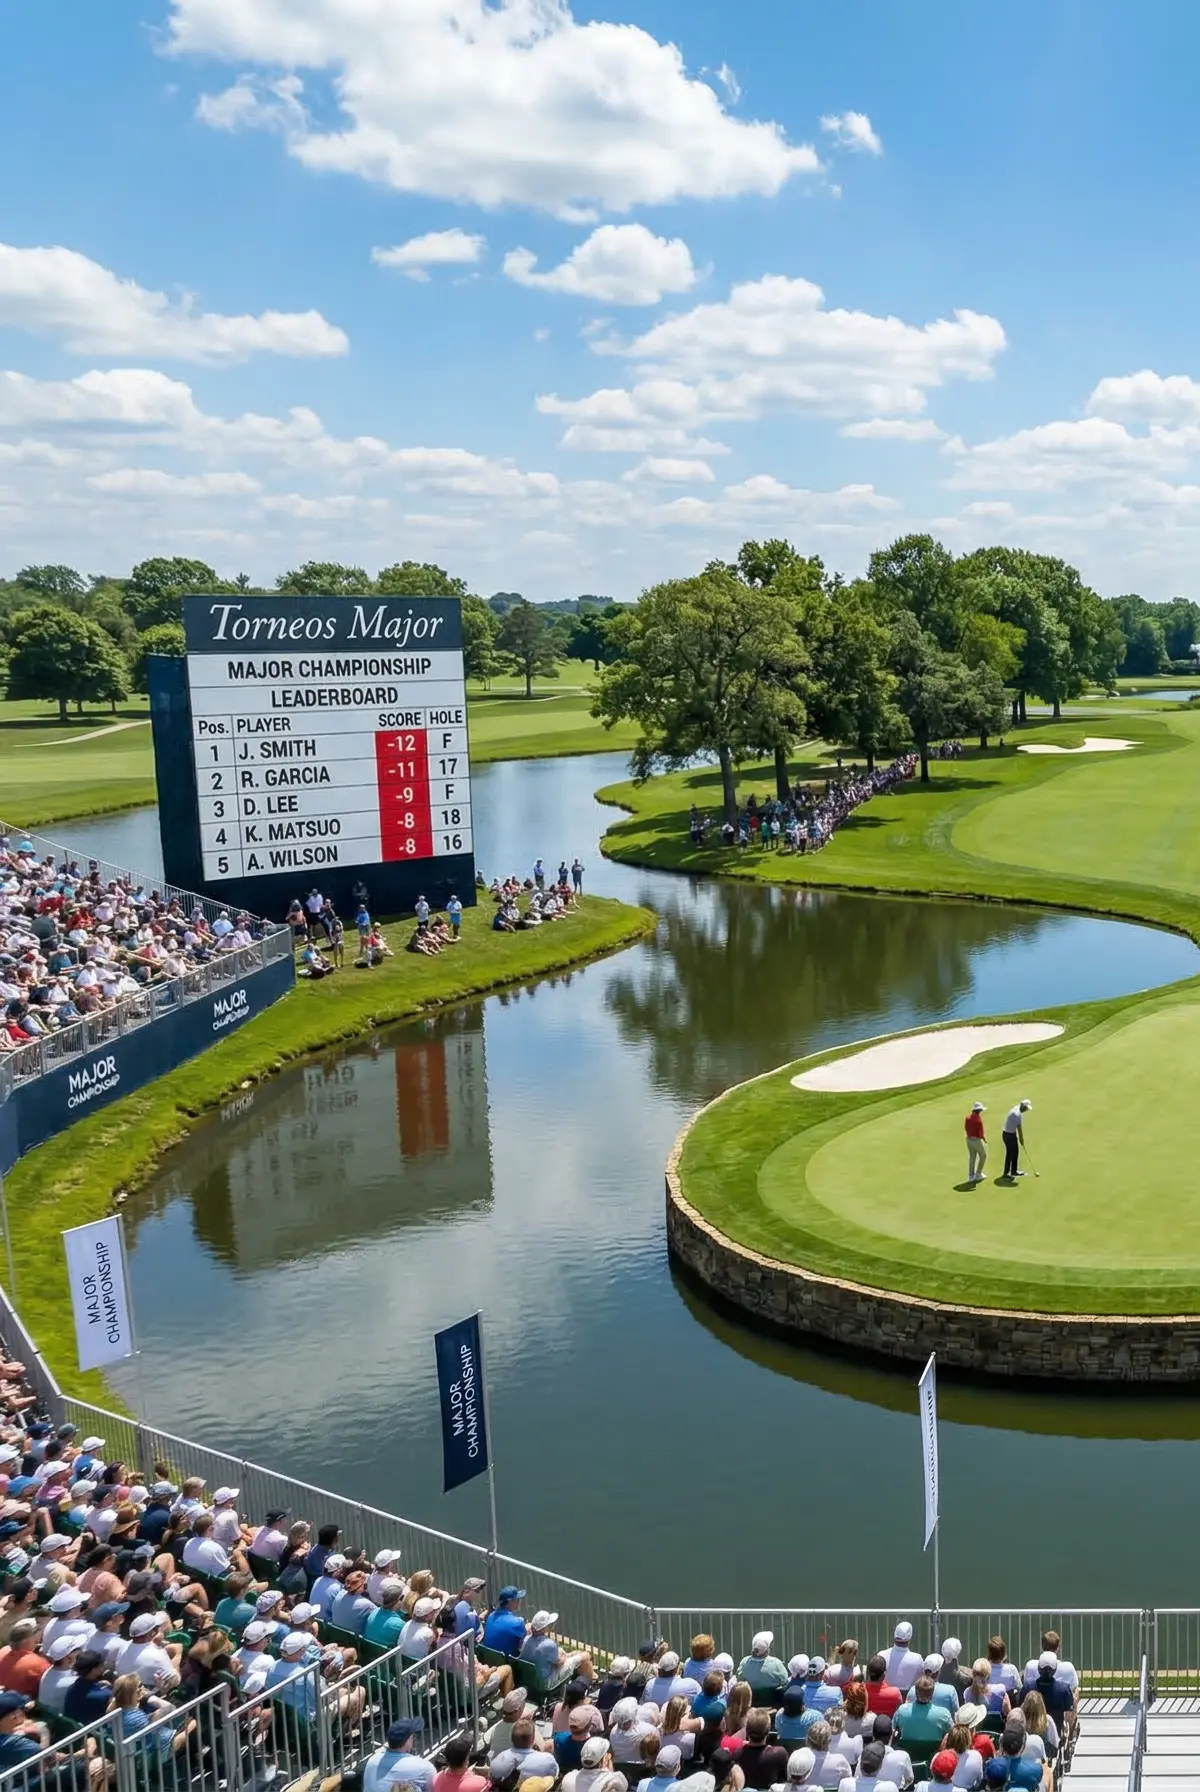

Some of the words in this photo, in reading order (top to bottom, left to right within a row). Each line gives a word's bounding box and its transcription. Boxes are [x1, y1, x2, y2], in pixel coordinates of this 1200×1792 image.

[210, 604, 336, 640] Torneos
[346, 605, 443, 648] Major
[228, 660, 293, 679] MAJOR
[299, 658, 431, 677] CHAMPIONSHIP
[271, 687, 398, 708] LEADERBOARD
[198, 720, 229, 735] Pos.
[237, 717, 291, 733] PLAYER
[379, 712, 422, 727] SCORE
[430, 710, 463, 725] HOLE
[210, 745, 219, 762] 1
[239, 743, 255, 760] J.
[260, 739, 316, 759] SMITH
[387, 735, 416, 752] -12
[443, 733, 453, 749] F
[211, 772, 223, 790] 2
[241, 771, 260, 788] R.
[265, 766, 331, 787] GARCIA
[388, 762, 415, 778] -11
[439, 758, 458, 775] 17
[213, 800, 225, 818] 3
[243, 798, 261, 816] D.
[267, 795, 299, 814] LEE
[396, 787, 414, 804] -9
[445, 784, 455, 800] F
[215, 828, 228, 845] 4
[245, 825, 263, 843] K.
[268, 818, 341, 841] MATSUO
[397, 812, 415, 829] -8
[442, 808, 461, 825] 18
[217, 856, 229, 874] 5
[247, 853, 264, 871] A.
[269, 845, 338, 868] WILSON
[399, 838, 416, 854] -8
[444, 834, 462, 851] 16
[213, 989, 247, 1018] MAJOR
[69, 1055, 117, 1093] MAJOR
[82, 1274, 101, 1325] MAJOR
[96, 1242, 120, 1344] CHAMPIONSHIP
[450, 1380, 465, 1437] MAJOR
[460, 1344, 479, 1458] CHAMPIONSHIP
